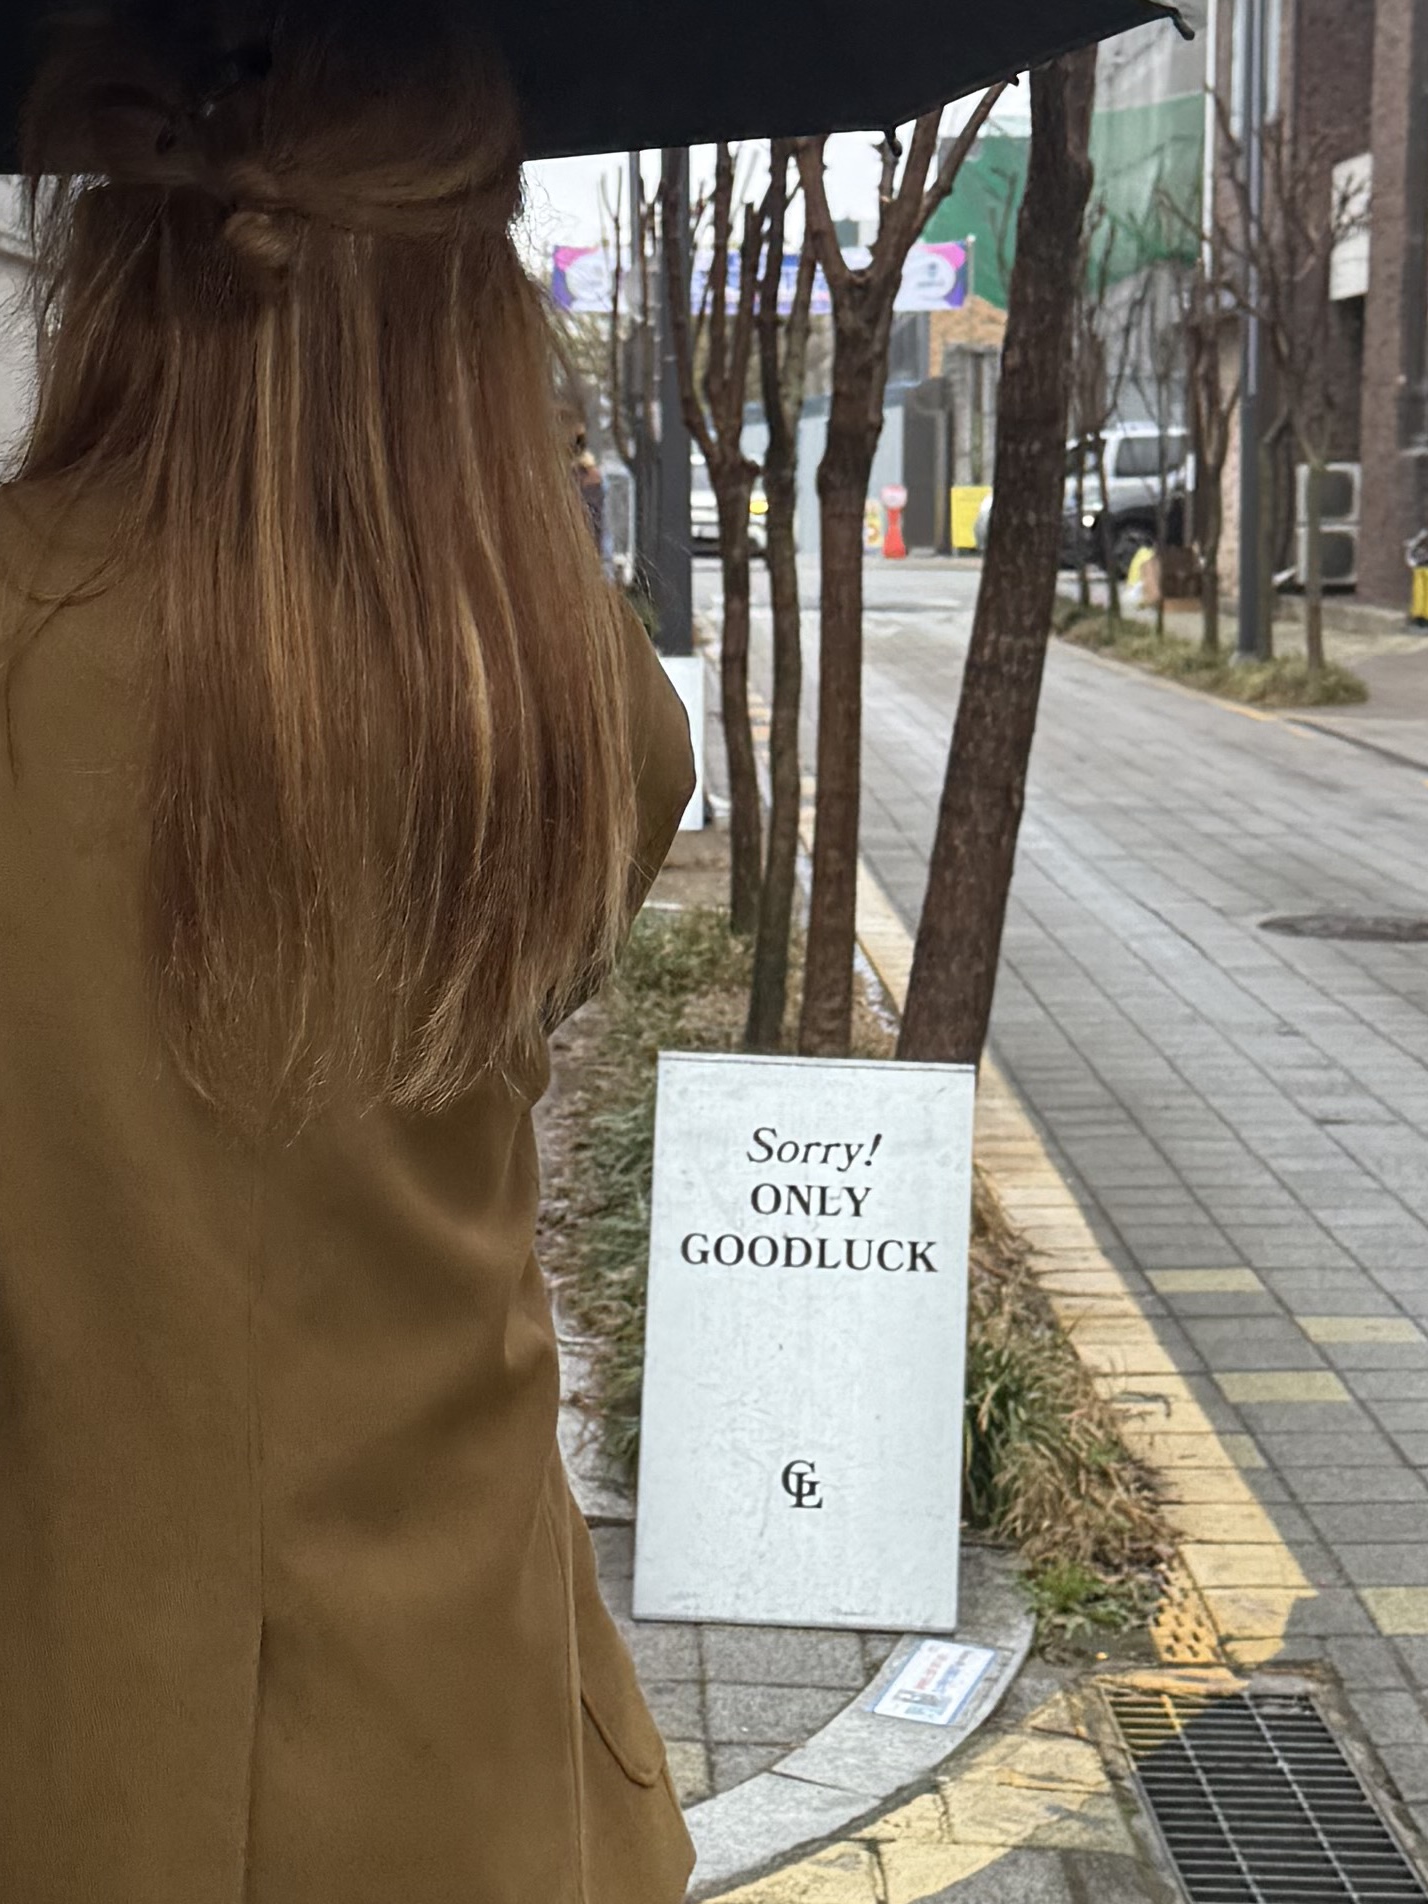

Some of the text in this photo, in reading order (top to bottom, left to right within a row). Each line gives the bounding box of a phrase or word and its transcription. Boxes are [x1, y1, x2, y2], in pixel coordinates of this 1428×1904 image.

[746, 1127, 883, 1173] Sorry!
[750, 1182, 873, 1217] ONLY
[680, 1232, 939, 1273] GOODLUCK
